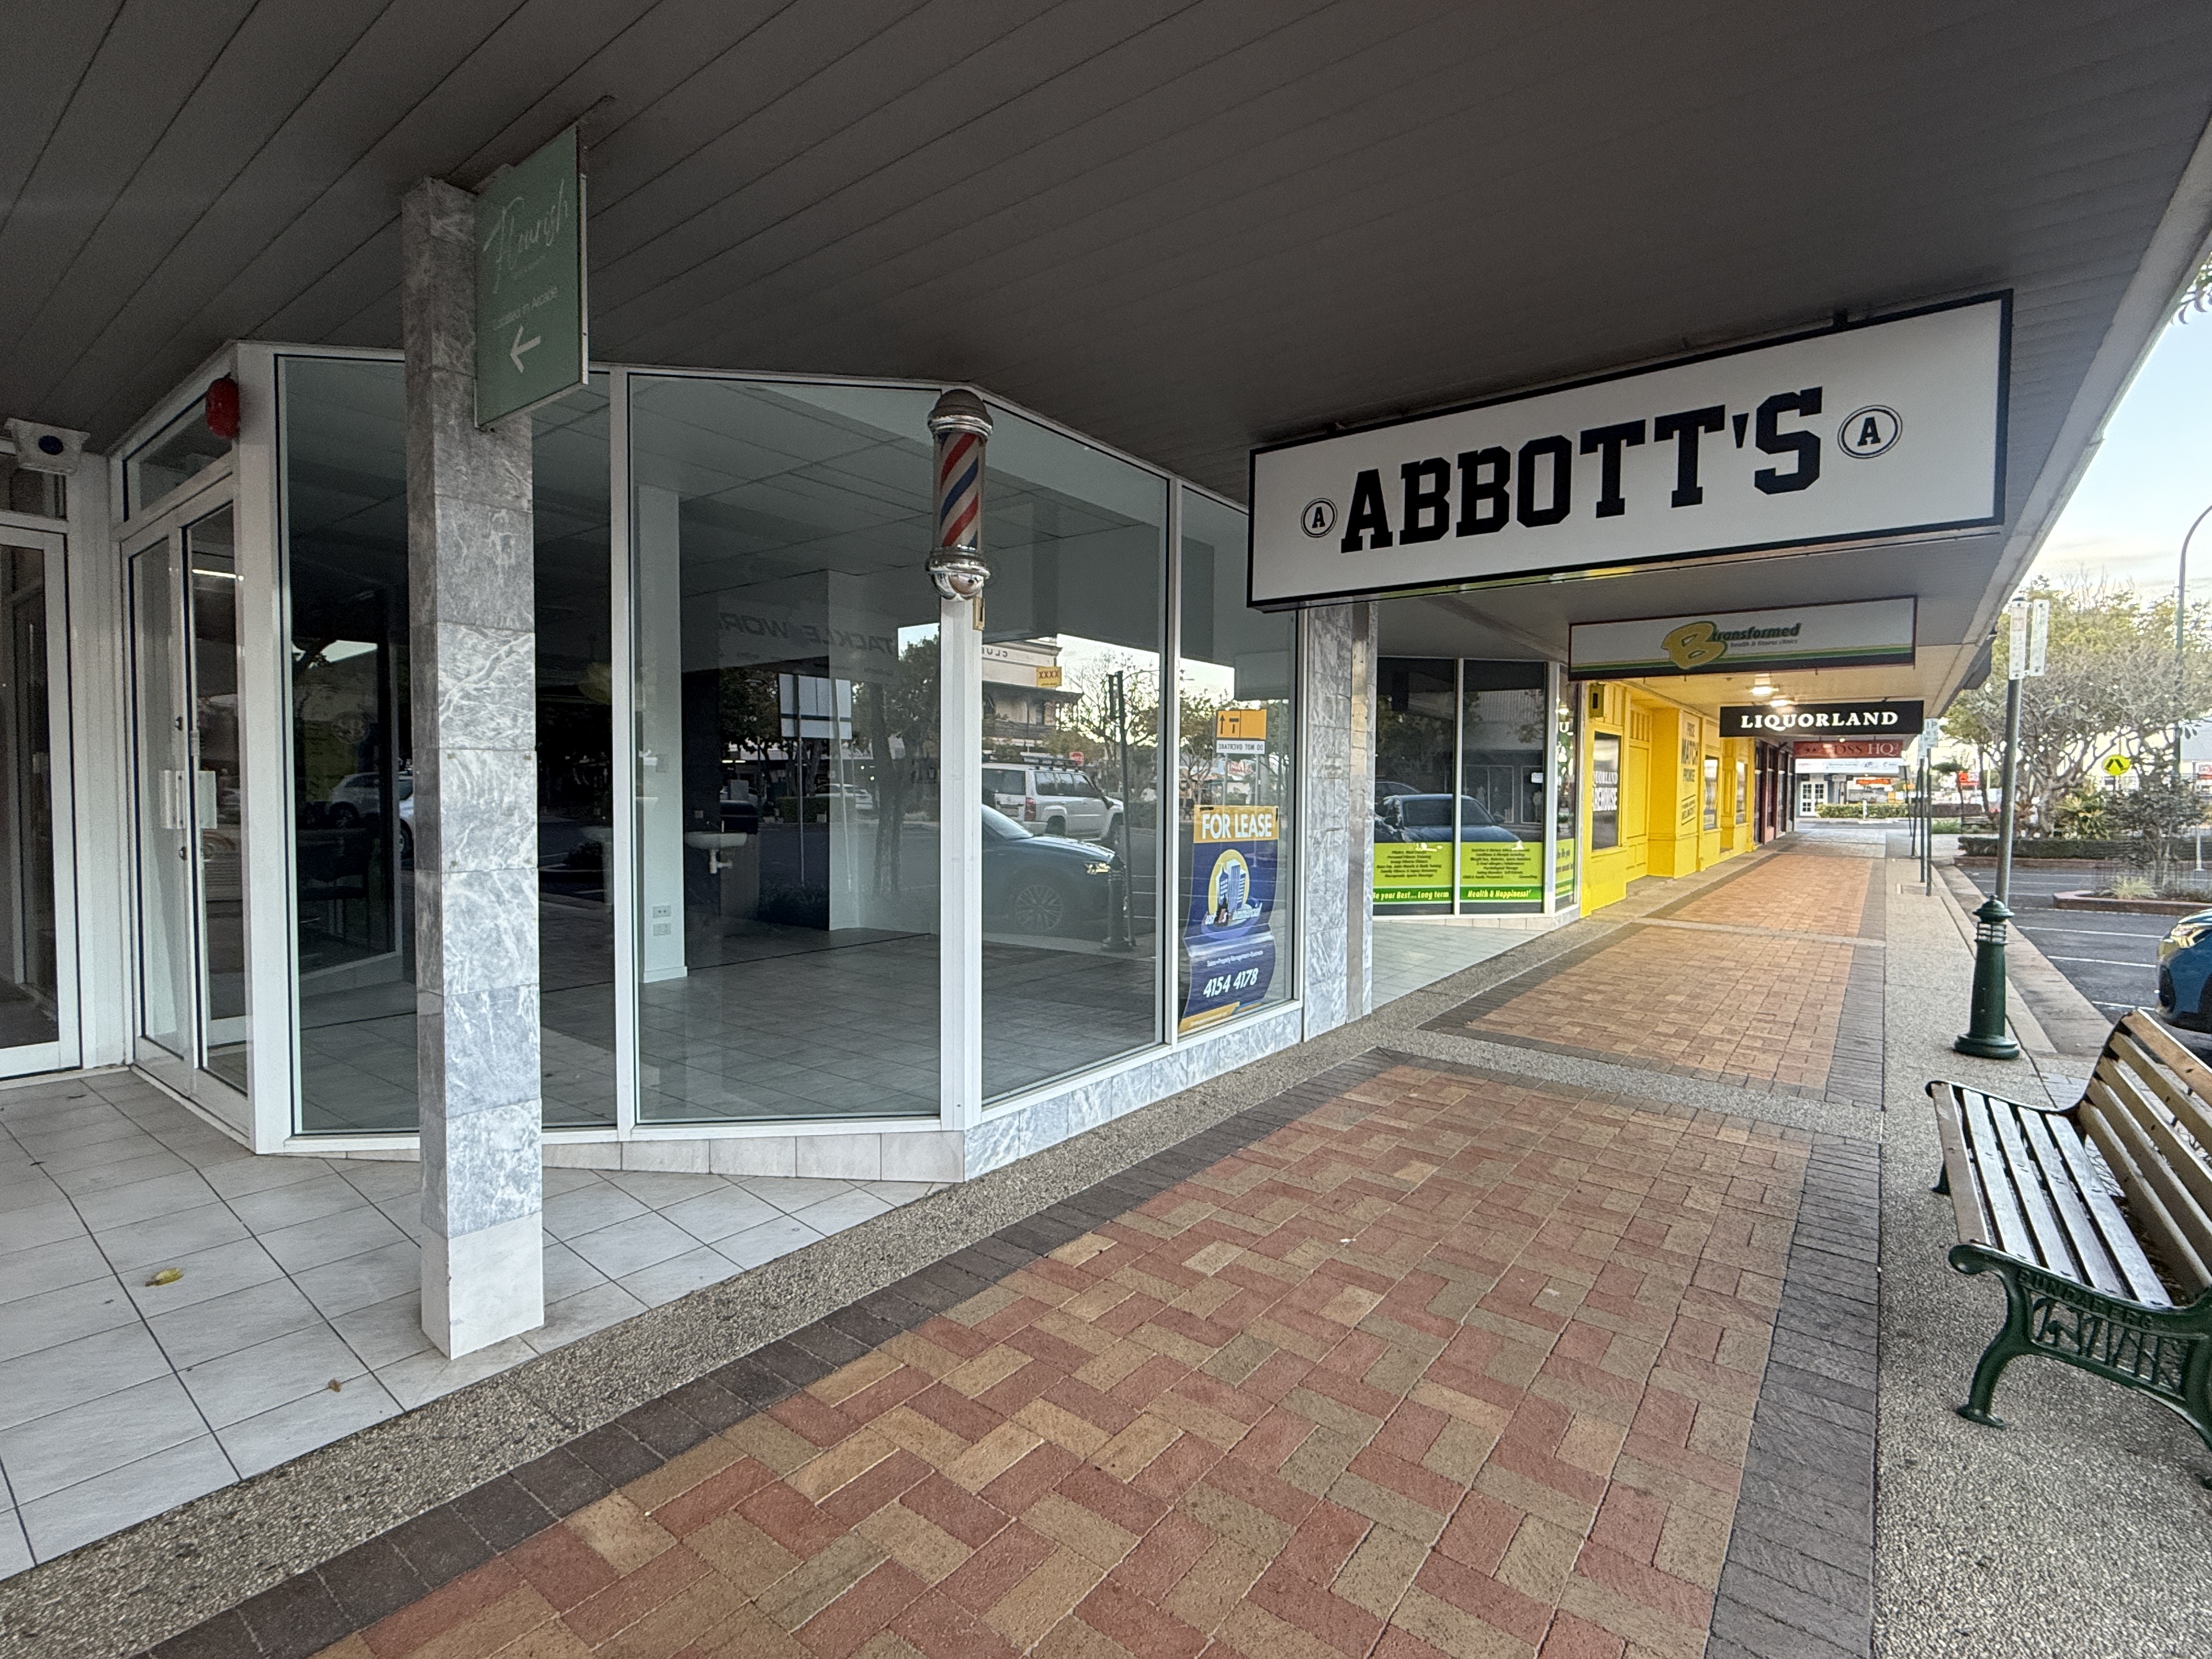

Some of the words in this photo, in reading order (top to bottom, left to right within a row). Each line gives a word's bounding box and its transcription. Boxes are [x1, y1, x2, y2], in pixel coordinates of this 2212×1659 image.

[1311, 506, 1327, 529] A
[1340, 386, 1824, 554] ABBOTT'S
[1857, 416, 1882, 448] A
[1740, 712, 1899, 731] LIQUORLAND
[1201, 813, 1232, 839] FOR
[1234, 813, 1272, 838] LEASE
[1380, 892, 1396, 901] your
[1418, 891, 1432, 900] Long
[1467, 889, 1488, 898] Health
[1203, 974, 1232, 998] 4154
[1233, 967, 1259, 990] 4178
[2019, 1268, 2154, 1329] BUNDABERG
